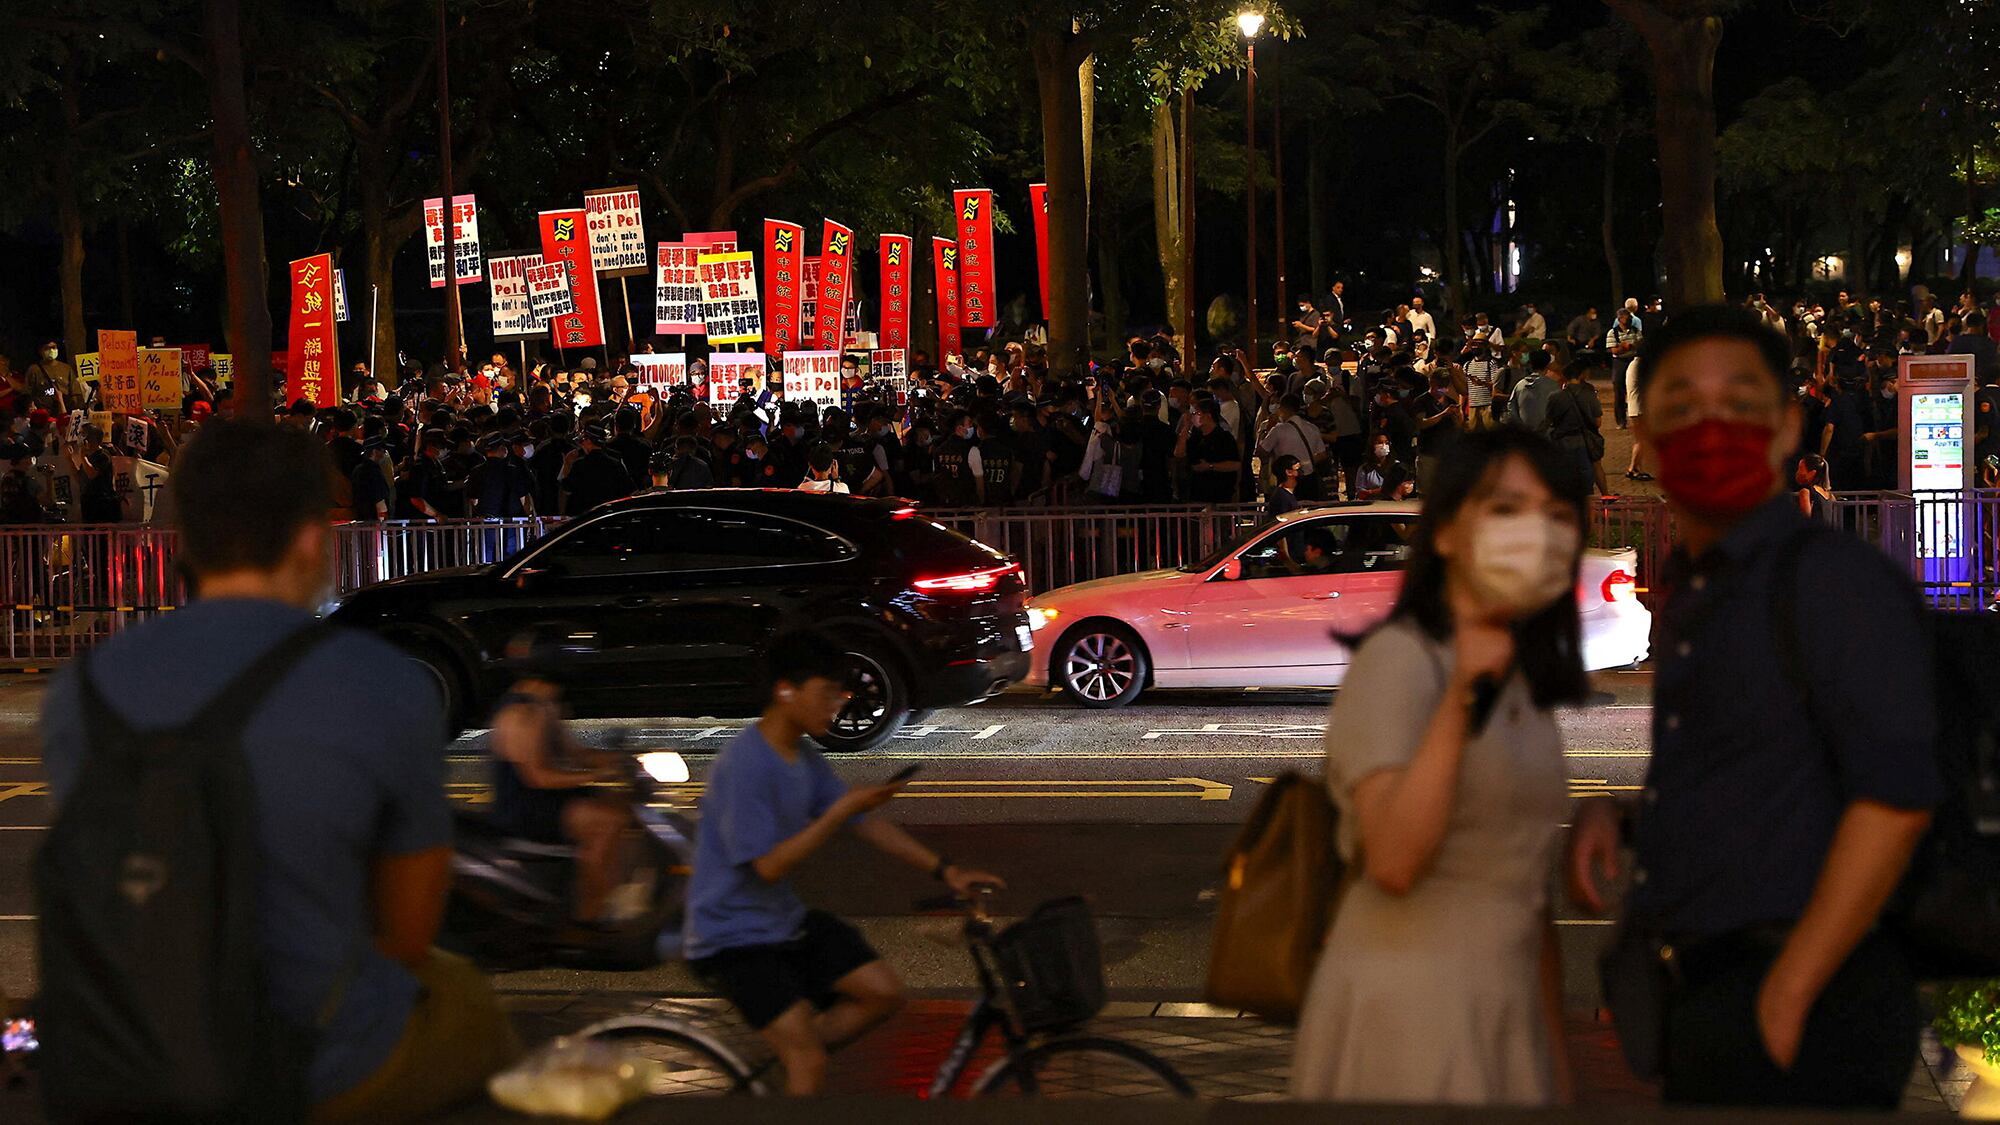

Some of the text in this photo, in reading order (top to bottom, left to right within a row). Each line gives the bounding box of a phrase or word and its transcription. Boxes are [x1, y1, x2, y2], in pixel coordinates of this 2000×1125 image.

[590, 213, 640, 230] osi Pel
[597, 231, 638, 243] don't make
[592, 242, 645, 254] trouble for us
[431, 257, 479, 278] 我們和平
[604, 254, 619, 266] need
[619, 252, 646, 267] peace
[527, 263, 564, 283] 戰爭販子
[700, 260, 753, 283] 戰爭販子
[502, 299, 517, 311] don't
[889, 271, 902, 349] 中華統一促
[657, 304, 705, 323] 我們需要和平
[505, 317, 520, 328] need
[707, 315, 760, 336] 我們需要和平
[144, 353, 161, 364] No
[785, 357, 810, 376] onger
[639, 364, 685, 385] armonger
[144, 380, 161, 391] No
[786, 377, 838, 391] osi Pel
[817, 396, 834, 405] make
